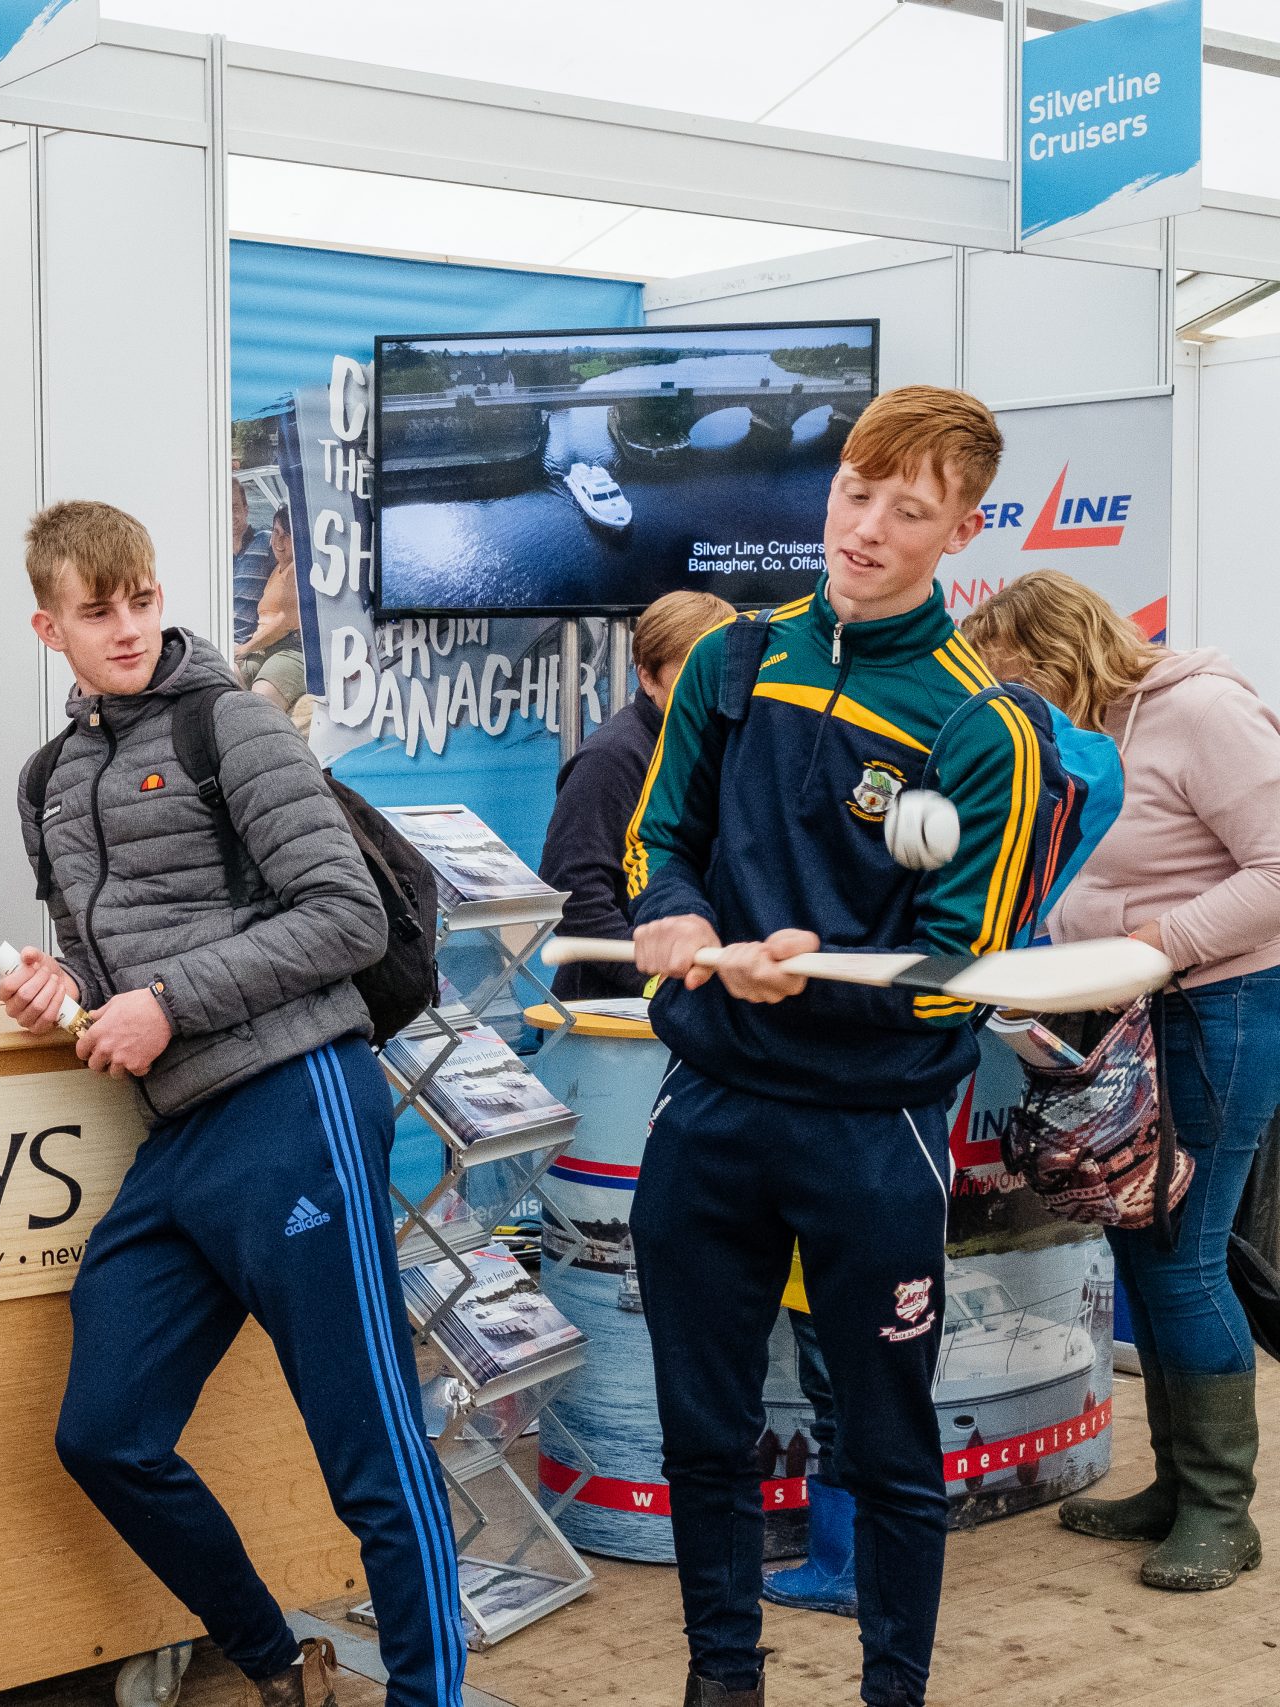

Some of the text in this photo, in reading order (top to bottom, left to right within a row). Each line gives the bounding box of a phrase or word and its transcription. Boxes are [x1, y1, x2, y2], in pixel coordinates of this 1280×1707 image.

[1029, 72, 1161, 124] Silverline
[1029, 114, 1148, 161] Cruisers
[318, 439, 372, 500] THE
[693, 540, 825, 556] Silver Line Cruisers
[689, 556, 827, 574] Banagher, Co. Offaly
[481, 1047, 507, 1060] Ireland
[285, 1212, 331, 1237] adidas
[486, 1275, 495, 1284] in
[494, 1266, 519, 1281] Ireland
